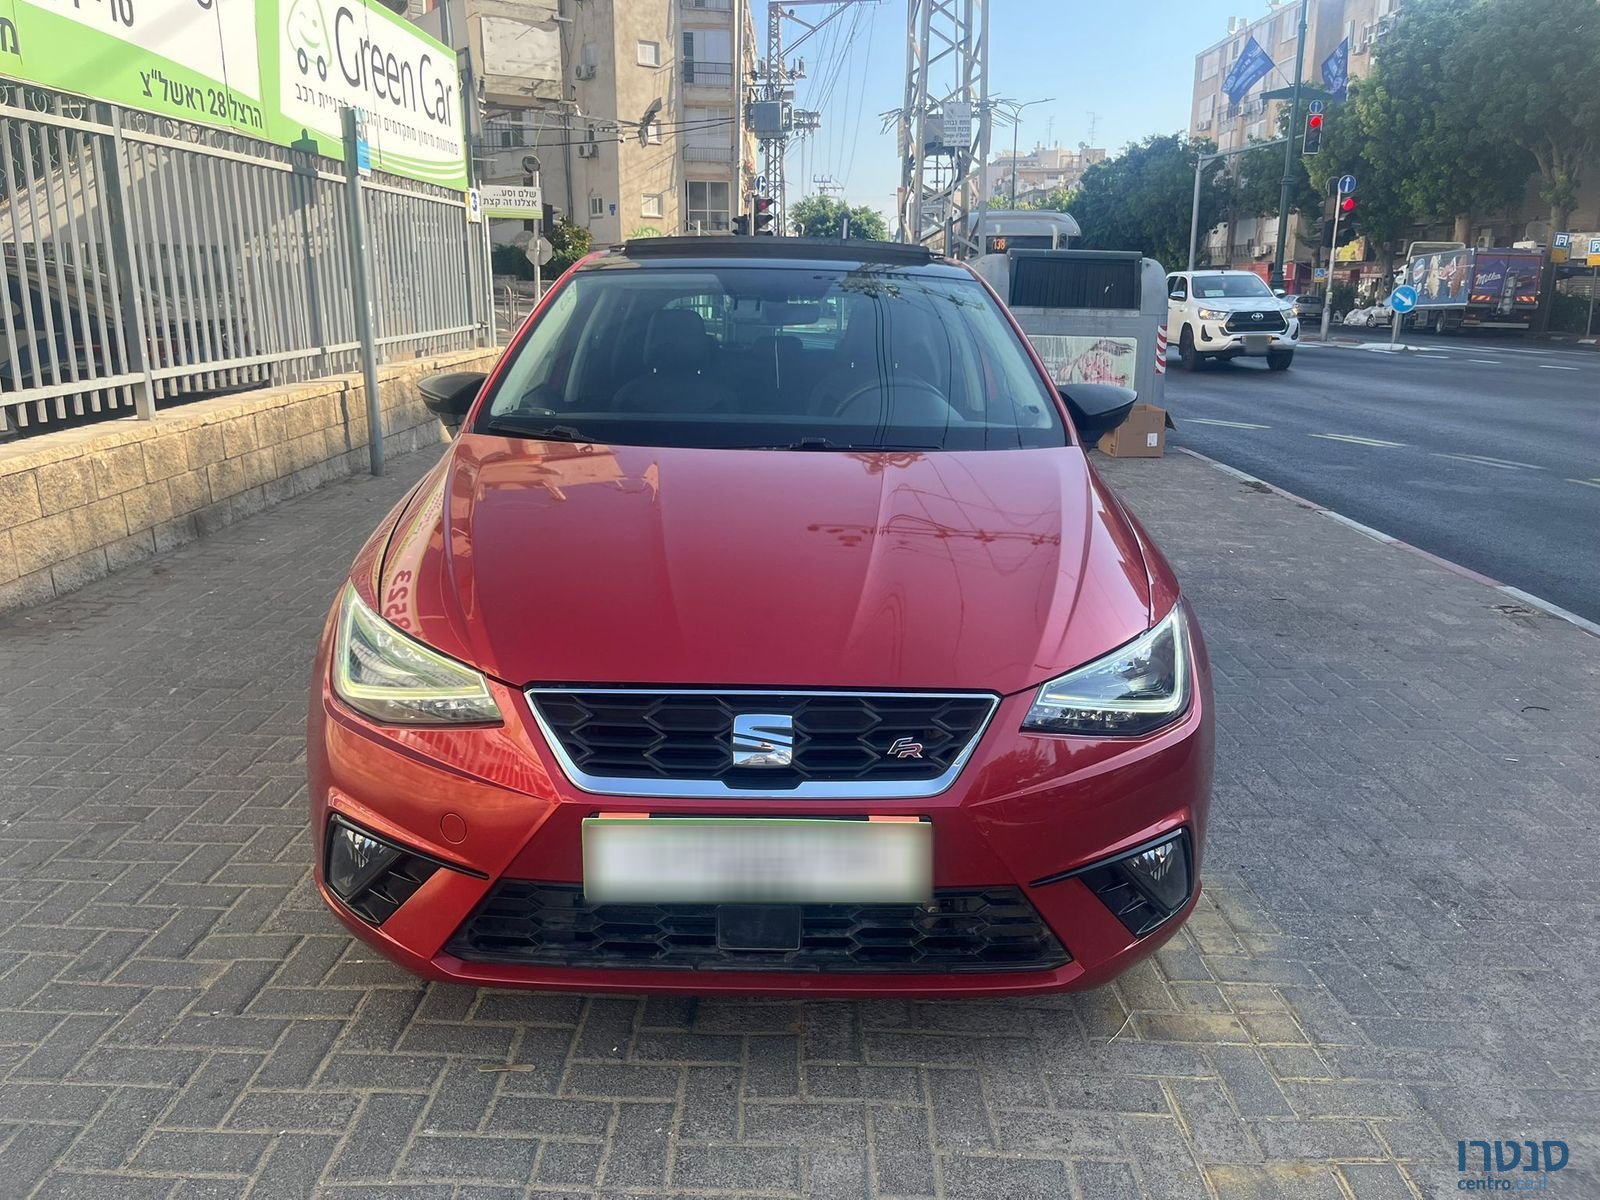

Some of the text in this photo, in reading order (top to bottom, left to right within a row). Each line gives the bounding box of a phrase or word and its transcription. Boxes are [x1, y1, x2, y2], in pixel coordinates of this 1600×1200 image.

[335, 6, 452, 127] Green Car
[207, 88, 227, 119] 28
[295, 83, 315, 105] רכב
[229, 94, 263, 129] הרצל
[483, 198, 500, 208] קצת
[515, 198, 537, 207] אצלנו
[518, 189, 536, 198] שלם
[1475, 272, 1501, 286] Milka
[887, 737, 923, 758] FR
